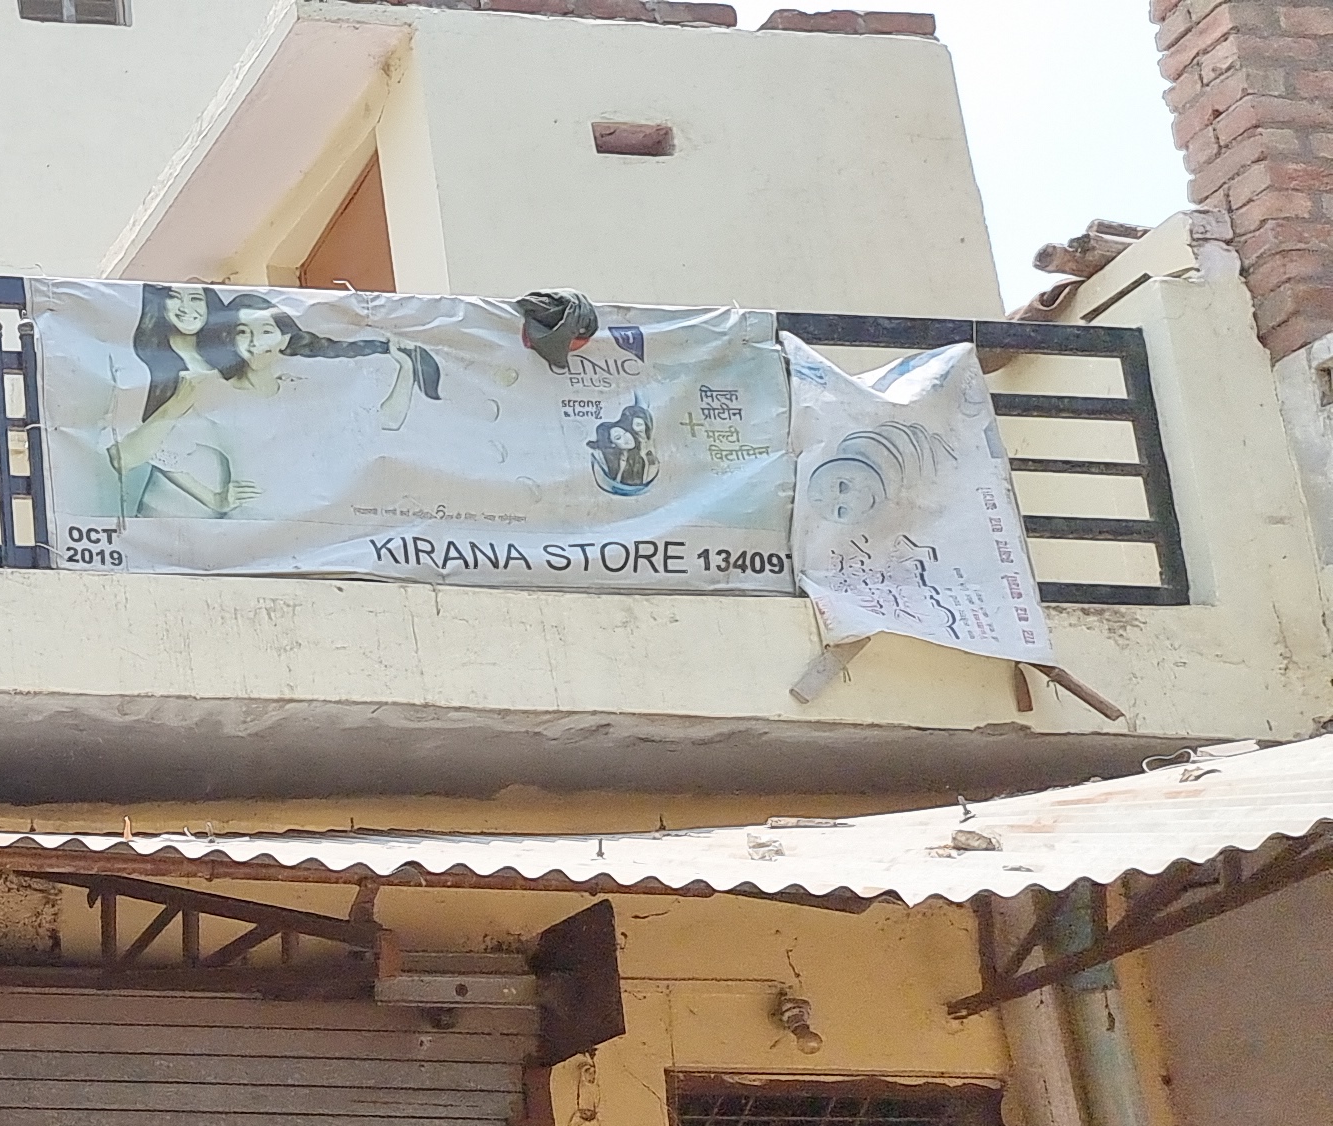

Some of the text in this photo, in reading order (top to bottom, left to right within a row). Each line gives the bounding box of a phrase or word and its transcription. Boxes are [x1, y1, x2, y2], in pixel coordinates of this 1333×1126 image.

[569, 376, 612, 388] PLUS
[699, 384, 739, 403] मिल्क
[572, 407, 603, 420] long
[700, 402, 744, 422] प्रोटीन
[704, 426, 741, 443] मल्टी
[707, 445, 770, 462] विटामिन
[68, 525, 118, 545] OCT
[65, 546, 123, 567] 2019
[369, 536, 792, 575] KIRANA STORE 13409
